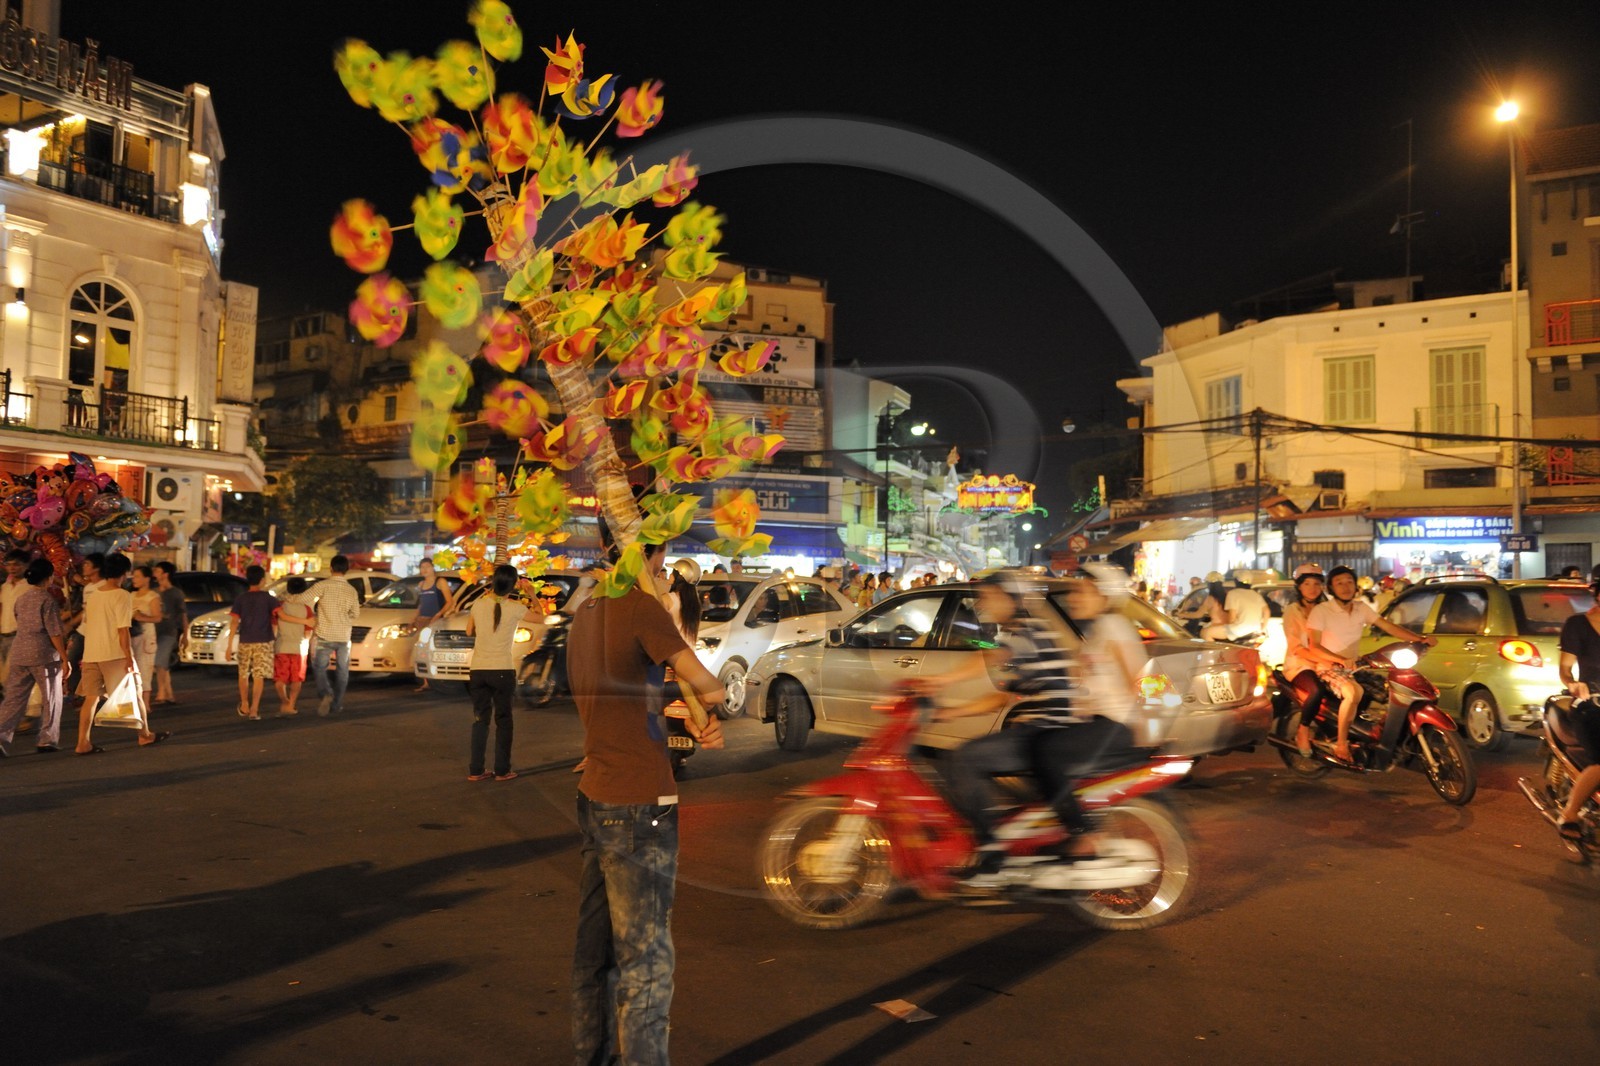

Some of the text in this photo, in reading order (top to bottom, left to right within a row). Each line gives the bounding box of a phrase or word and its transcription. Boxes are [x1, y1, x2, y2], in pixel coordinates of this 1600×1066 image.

[1377, 520, 1424, 538] Vinh
[1476, 519, 1483, 527] &
[1485, 518, 1505, 526] BÁN
